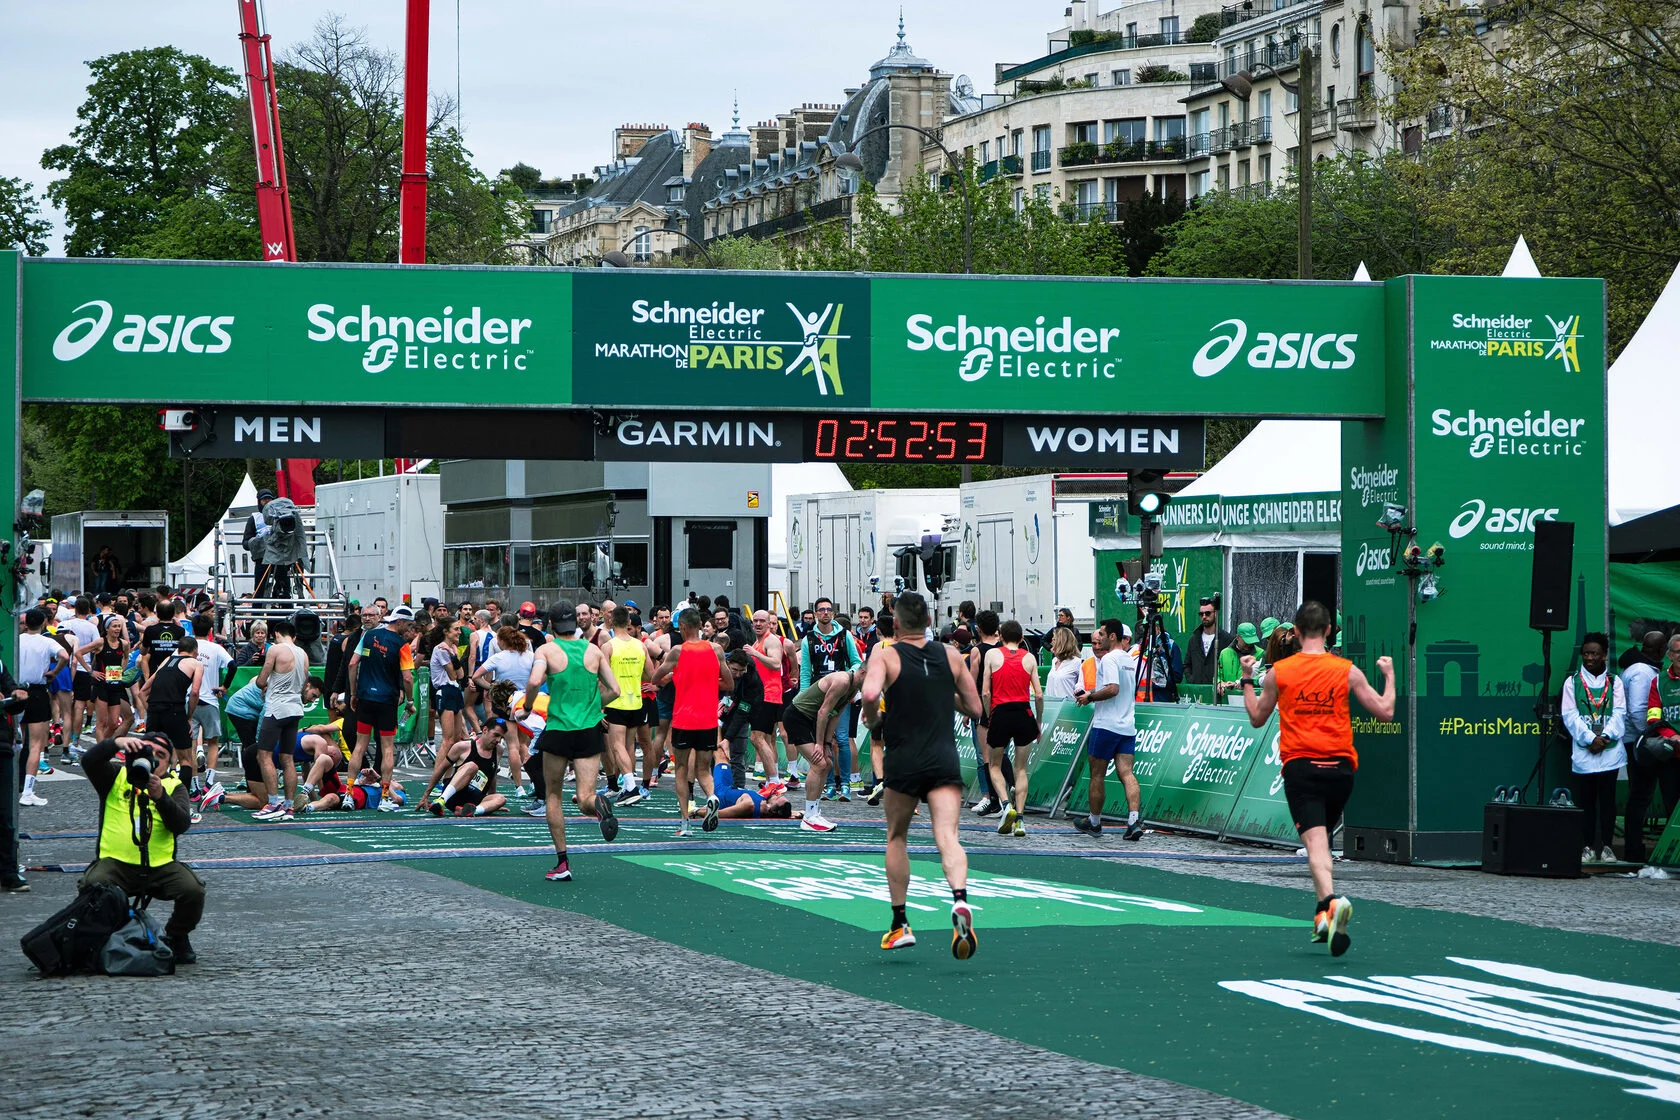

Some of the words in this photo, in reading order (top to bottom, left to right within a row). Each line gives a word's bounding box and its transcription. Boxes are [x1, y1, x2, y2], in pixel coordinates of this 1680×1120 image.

[308, 304, 531, 344] Schneider
[632, 300, 764, 325] Schneider
[1453, 313, 1532, 329] Schneider
[113, 315, 234, 353] asics
[690, 325, 761, 340] Electric
[907, 313, 1120, 354] Schneider
[1487, 329, 1530, 338] Electric
[405, 346, 527, 370] Electric
[595, 343, 688, 358] MARATHON
[676, 359, 688, 368] DE
[690, 345, 784, 369] PARIS
[1247, 332, 1357, 369] asics
[1431, 340, 1486, 349] MARATHON
[1488, 341, 1544, 356] PARIS
[999, 355, 1115, 378] Electric
[234, 416, 321, 442] MEN
[617, 420, 776, 446] GARMIN
[1432, 409, 1585, 437] Schneider
[815, 419, 988, 460] 02:52:53
[1027, 426, 1179, 453] WOMEN
[1499, 438, 1582, 455] Electric
[1351, 464, 1398, 489] Schneider
[1370, 489, 1397, 503] Electric
[1207, 502, 1250, 525] LOUNGE
[1253, 500, 1314, 524] SCHNEIDER
[1480, 541, 1505, 549] sound
[1367, 547, 1391, 570] asics
[1050, 726, 1081, 745] Schneider
[1134, 719, 1172, 754] eider
[1180, 721, 1253, 762] Schneider
[1195, 760, 1239, 786] Electric
